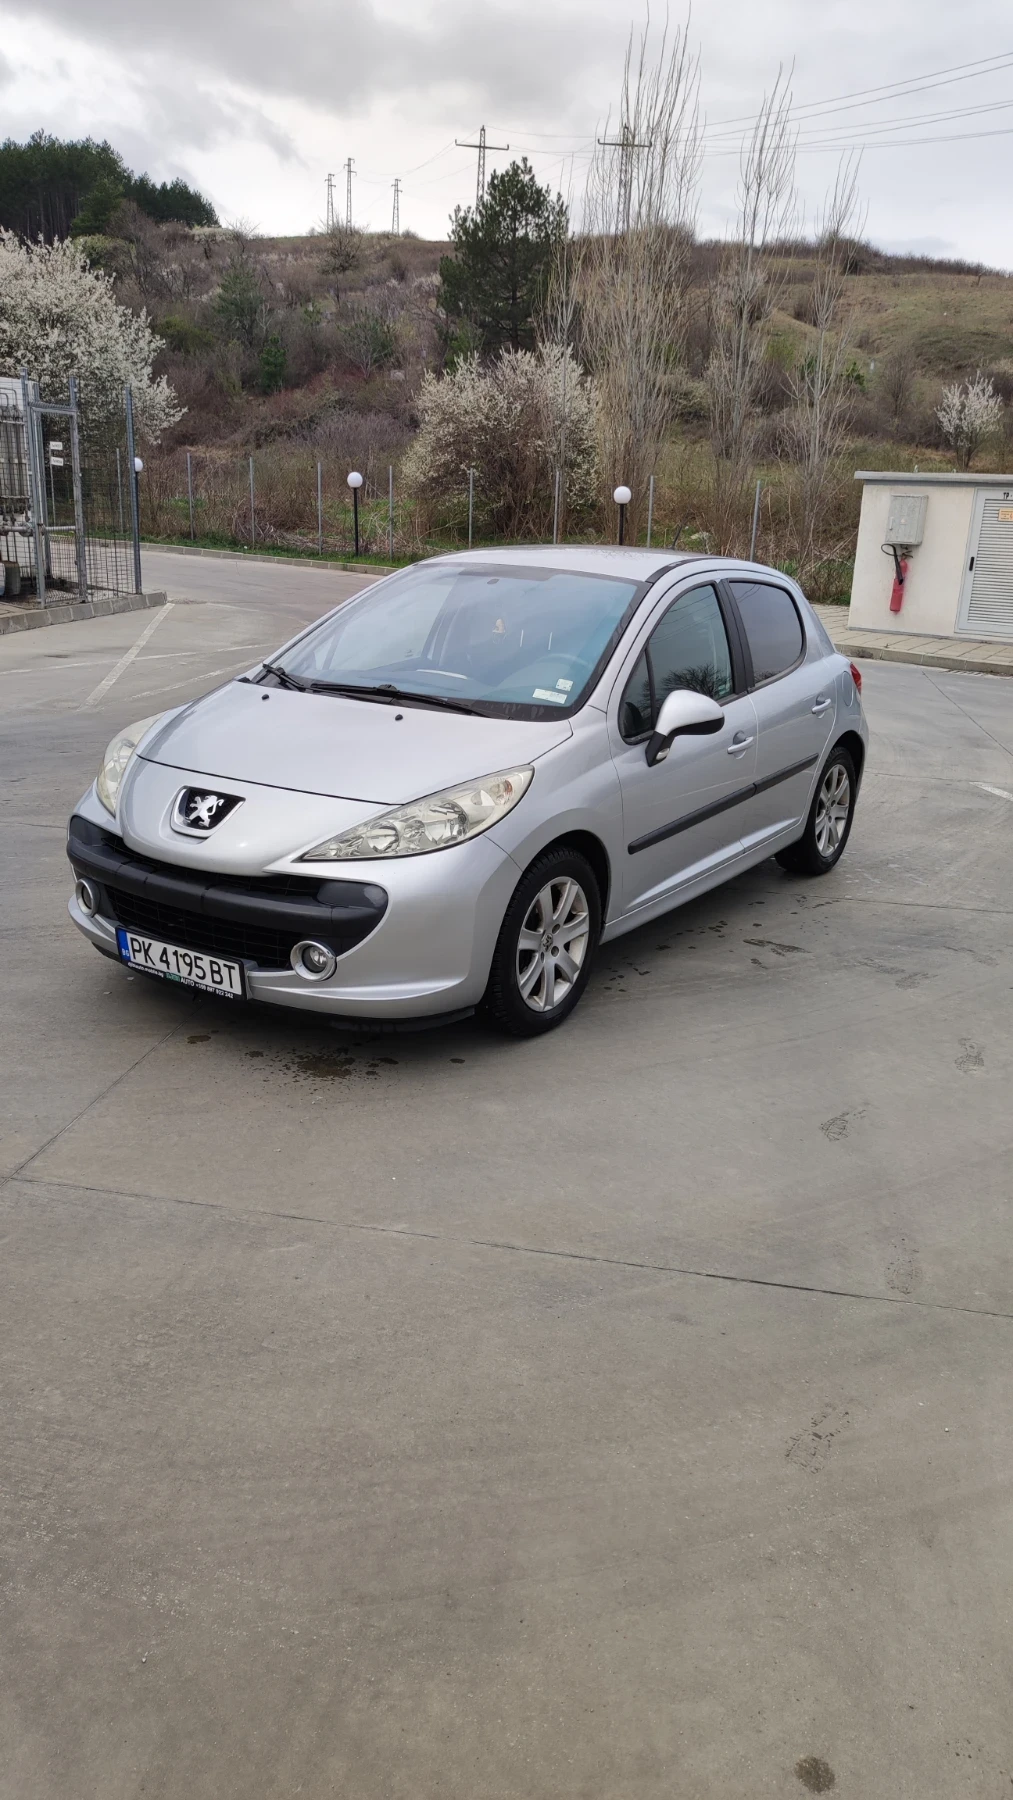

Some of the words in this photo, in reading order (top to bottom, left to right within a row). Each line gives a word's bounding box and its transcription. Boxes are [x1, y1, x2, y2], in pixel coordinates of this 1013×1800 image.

[121, 948, 130, 957] BG
[130, 937, 156, 966] PK
[160, 947, 206, 980] 4195
[209, 960, 236, 989] BT
[180, 977, 195, 987] AUTO
